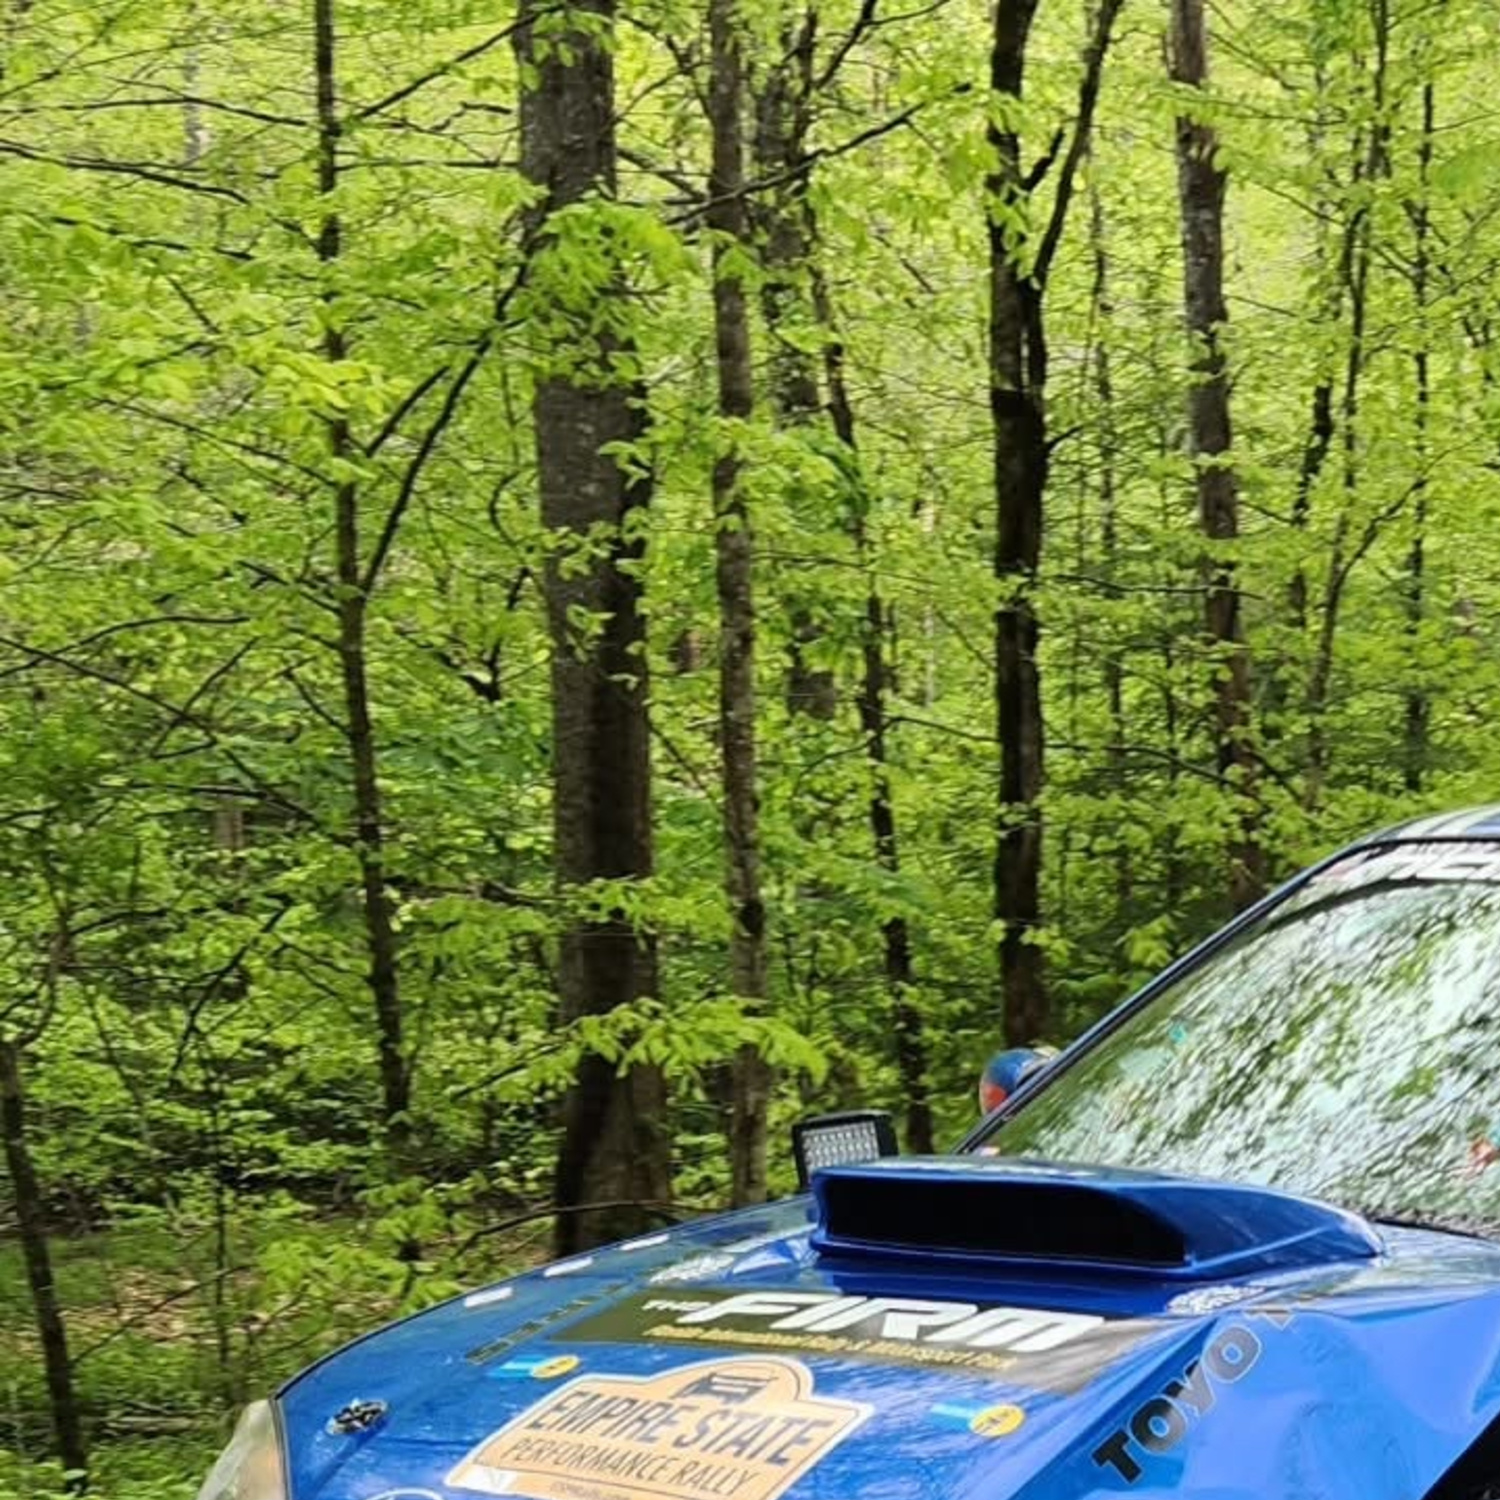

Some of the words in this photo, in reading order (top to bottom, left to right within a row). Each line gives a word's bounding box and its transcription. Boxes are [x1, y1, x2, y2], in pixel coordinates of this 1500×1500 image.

[672, 1292, 1104, 1352] FIRM
[524, 1390, 687, 1444] EMPIRE
[673, 1404, 835, 1466] STATE
[1091, 1324, 1262, 1485] TOYO
[501, 1437, 669, 1485] PERFORMANCE
[668, 1461, 762, 1496] RALLY
